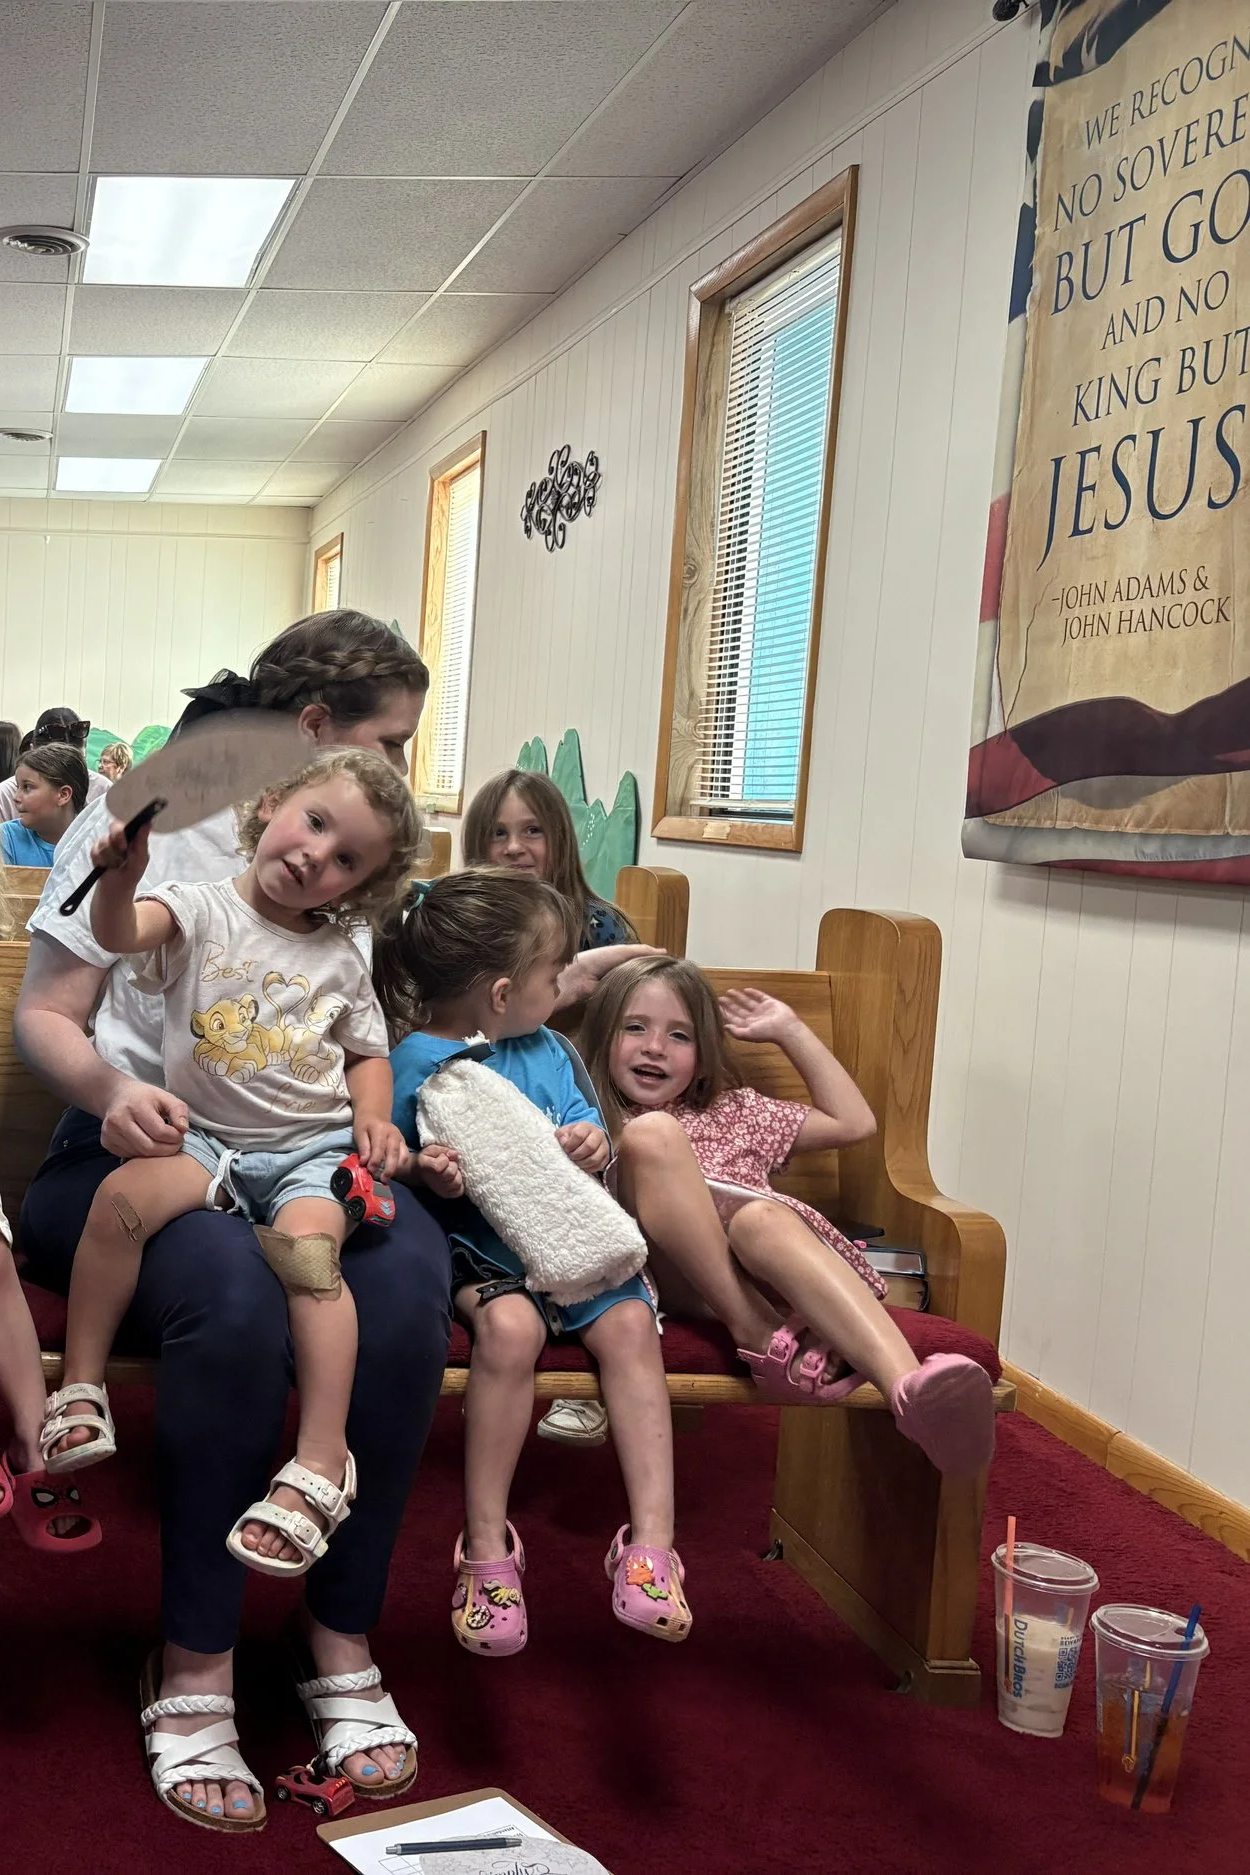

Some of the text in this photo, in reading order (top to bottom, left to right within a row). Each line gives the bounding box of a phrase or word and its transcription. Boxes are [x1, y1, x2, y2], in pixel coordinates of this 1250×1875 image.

[1053, 92, 1250, 232] NO SOVERE
[1085, 102, 1121, 149] WE
[1050, 168, 1250, 315] BUT GO
[1100, 270, 1229, 351] AND NO
[1072, 326, 1250, 427] KING BUT
[1036, 404, 1247, 572] JESUS
[1061, 596, 1231, 647] JOHN HANCOCK
[1111, 568, 1188, 602] ADAMS
[1193, 565, 1210, 591] &
[201, 940, 258, 983] Best
